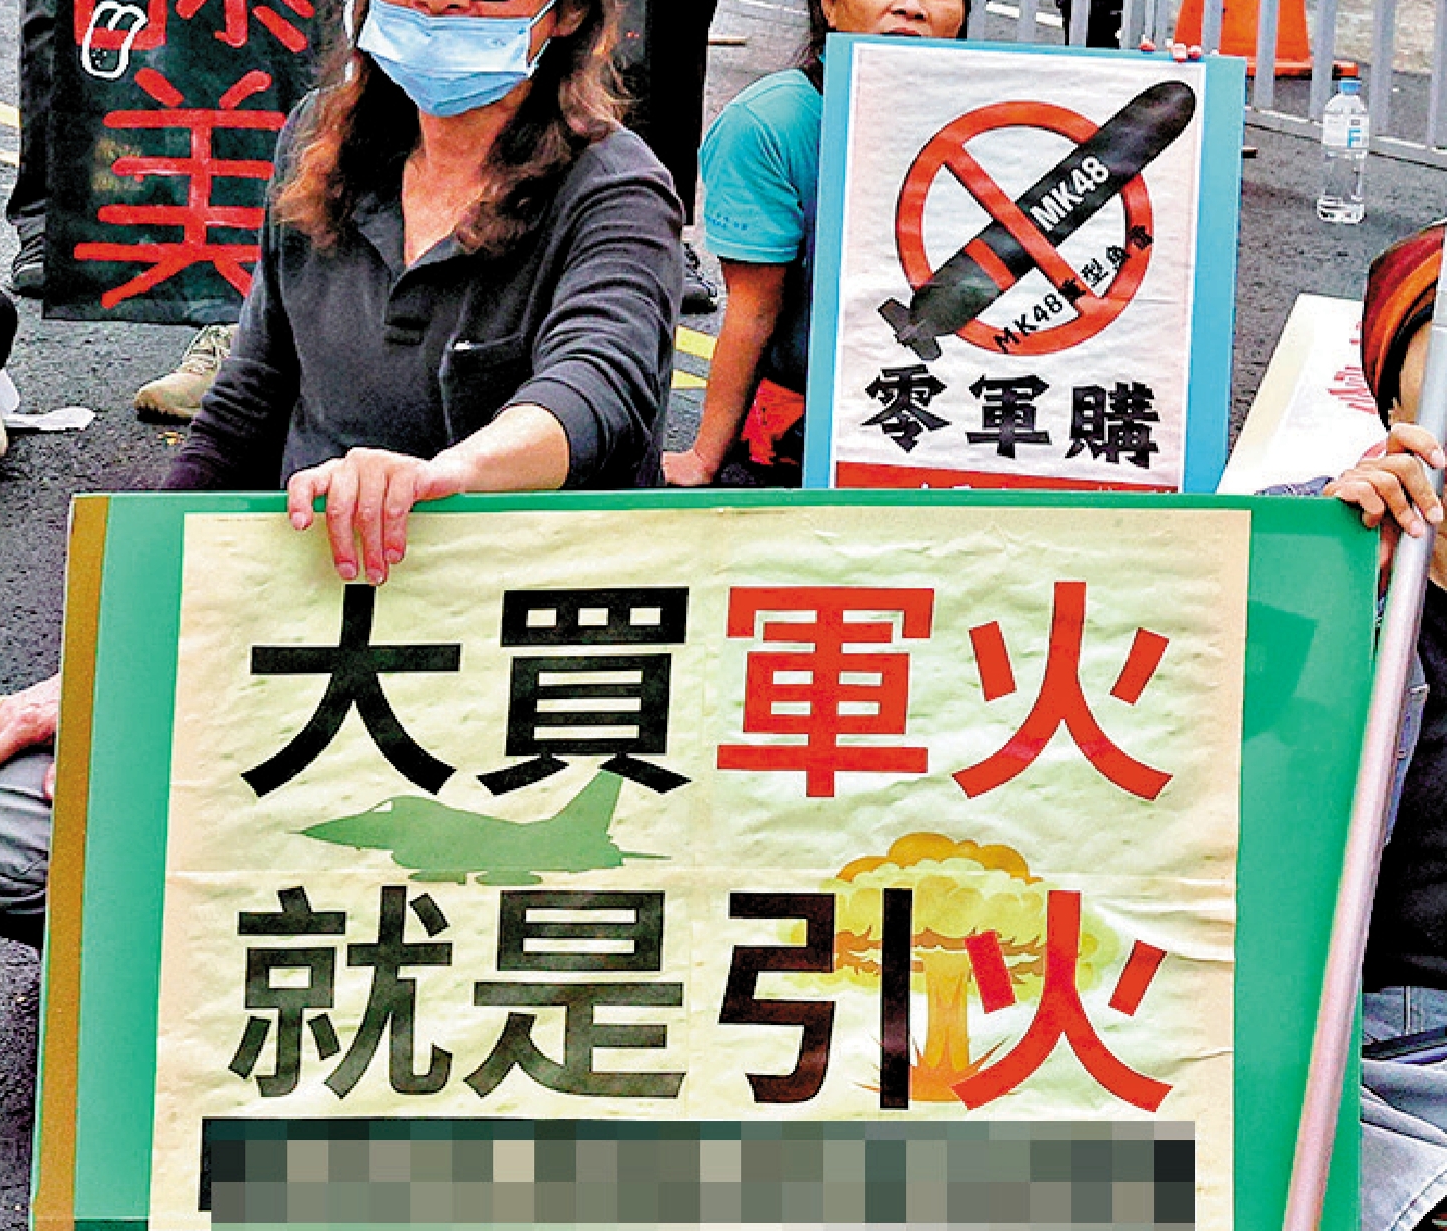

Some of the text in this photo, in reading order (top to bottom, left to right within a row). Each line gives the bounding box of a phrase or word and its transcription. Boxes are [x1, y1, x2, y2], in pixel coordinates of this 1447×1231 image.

[1031, 156, 1110, 233] MK48
[861, 363, 1161, 470] 零軍購
[241, 581, 1173, 801] 大買軍火
[228, 886, 1173, 1113] 就是引火
